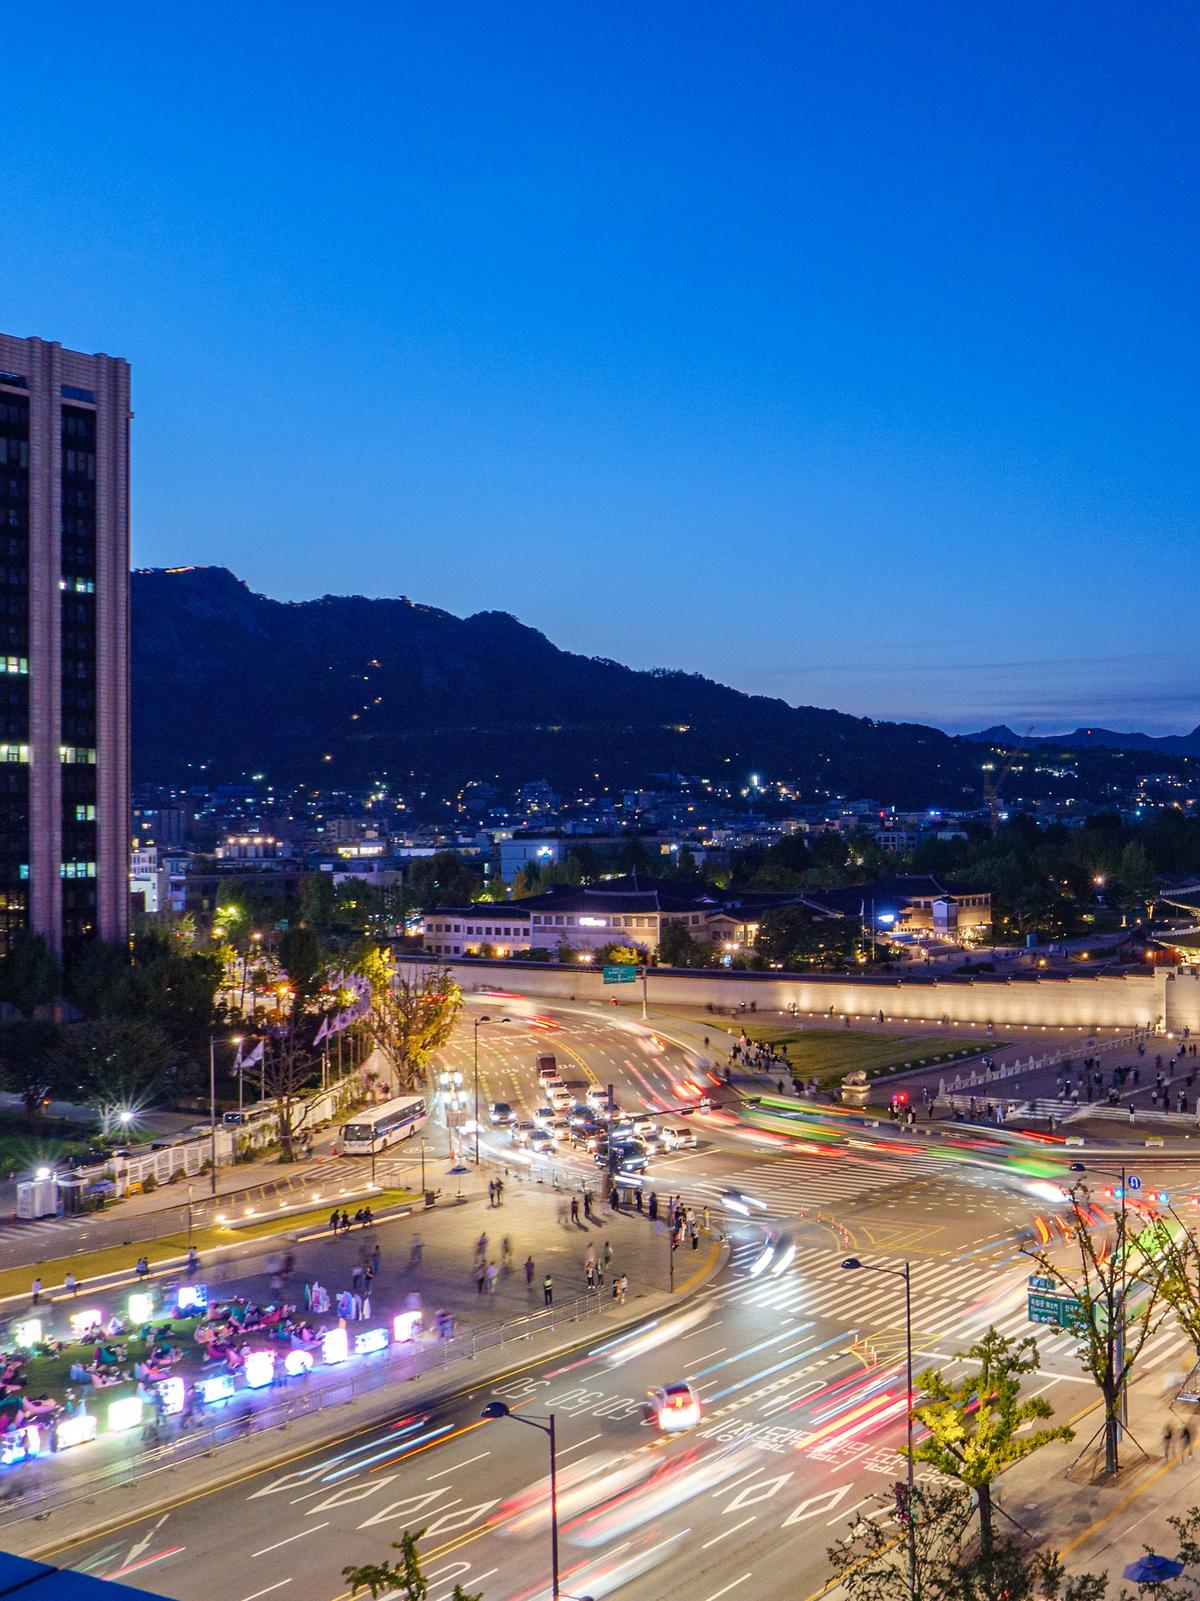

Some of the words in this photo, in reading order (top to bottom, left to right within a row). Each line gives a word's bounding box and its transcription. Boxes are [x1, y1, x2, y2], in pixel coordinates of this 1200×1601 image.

[491, 1377, 551, 1400] 50
[544, 1388, 604, 1411] 50
[592, 1398, 653, 1421] 50
